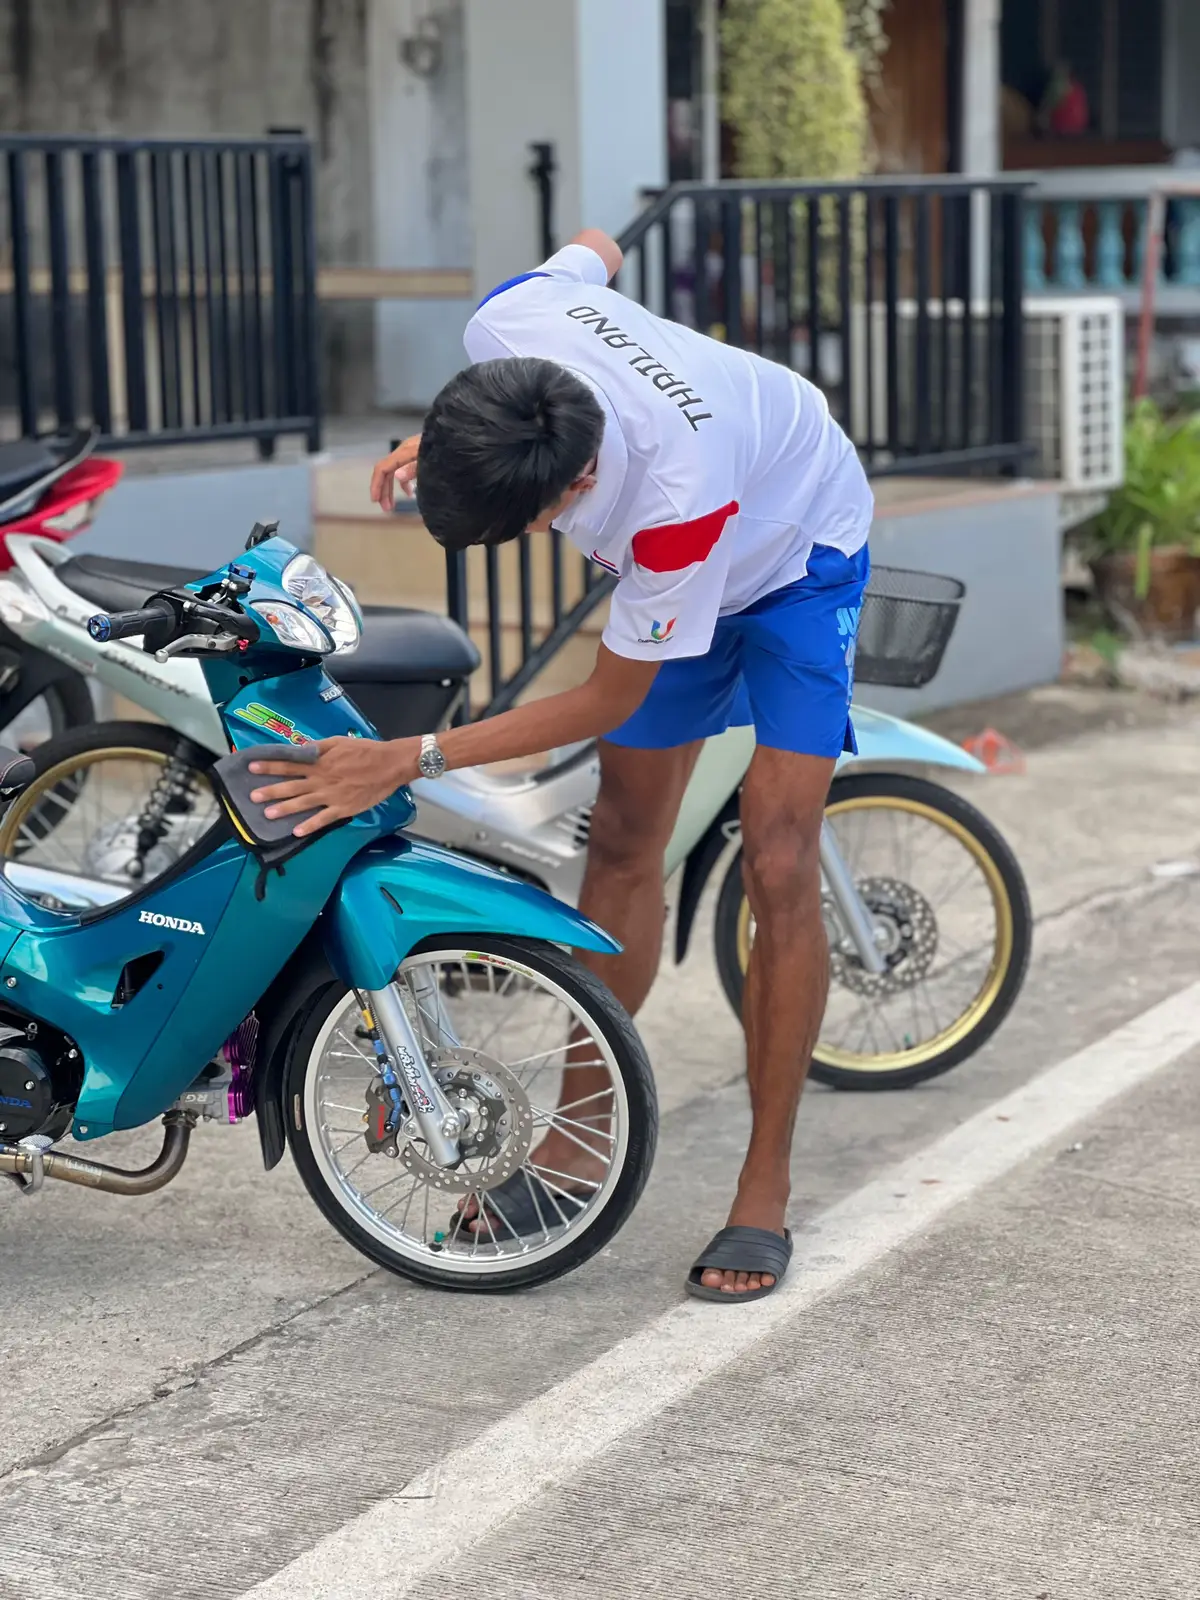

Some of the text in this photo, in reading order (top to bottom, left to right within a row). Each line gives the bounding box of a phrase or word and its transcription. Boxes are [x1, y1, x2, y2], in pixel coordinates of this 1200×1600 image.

[566, 306, 713, 432] THAILAND
[139, 910, 205, 935] HONDA
[185, 1093, 209, 1103] RG
